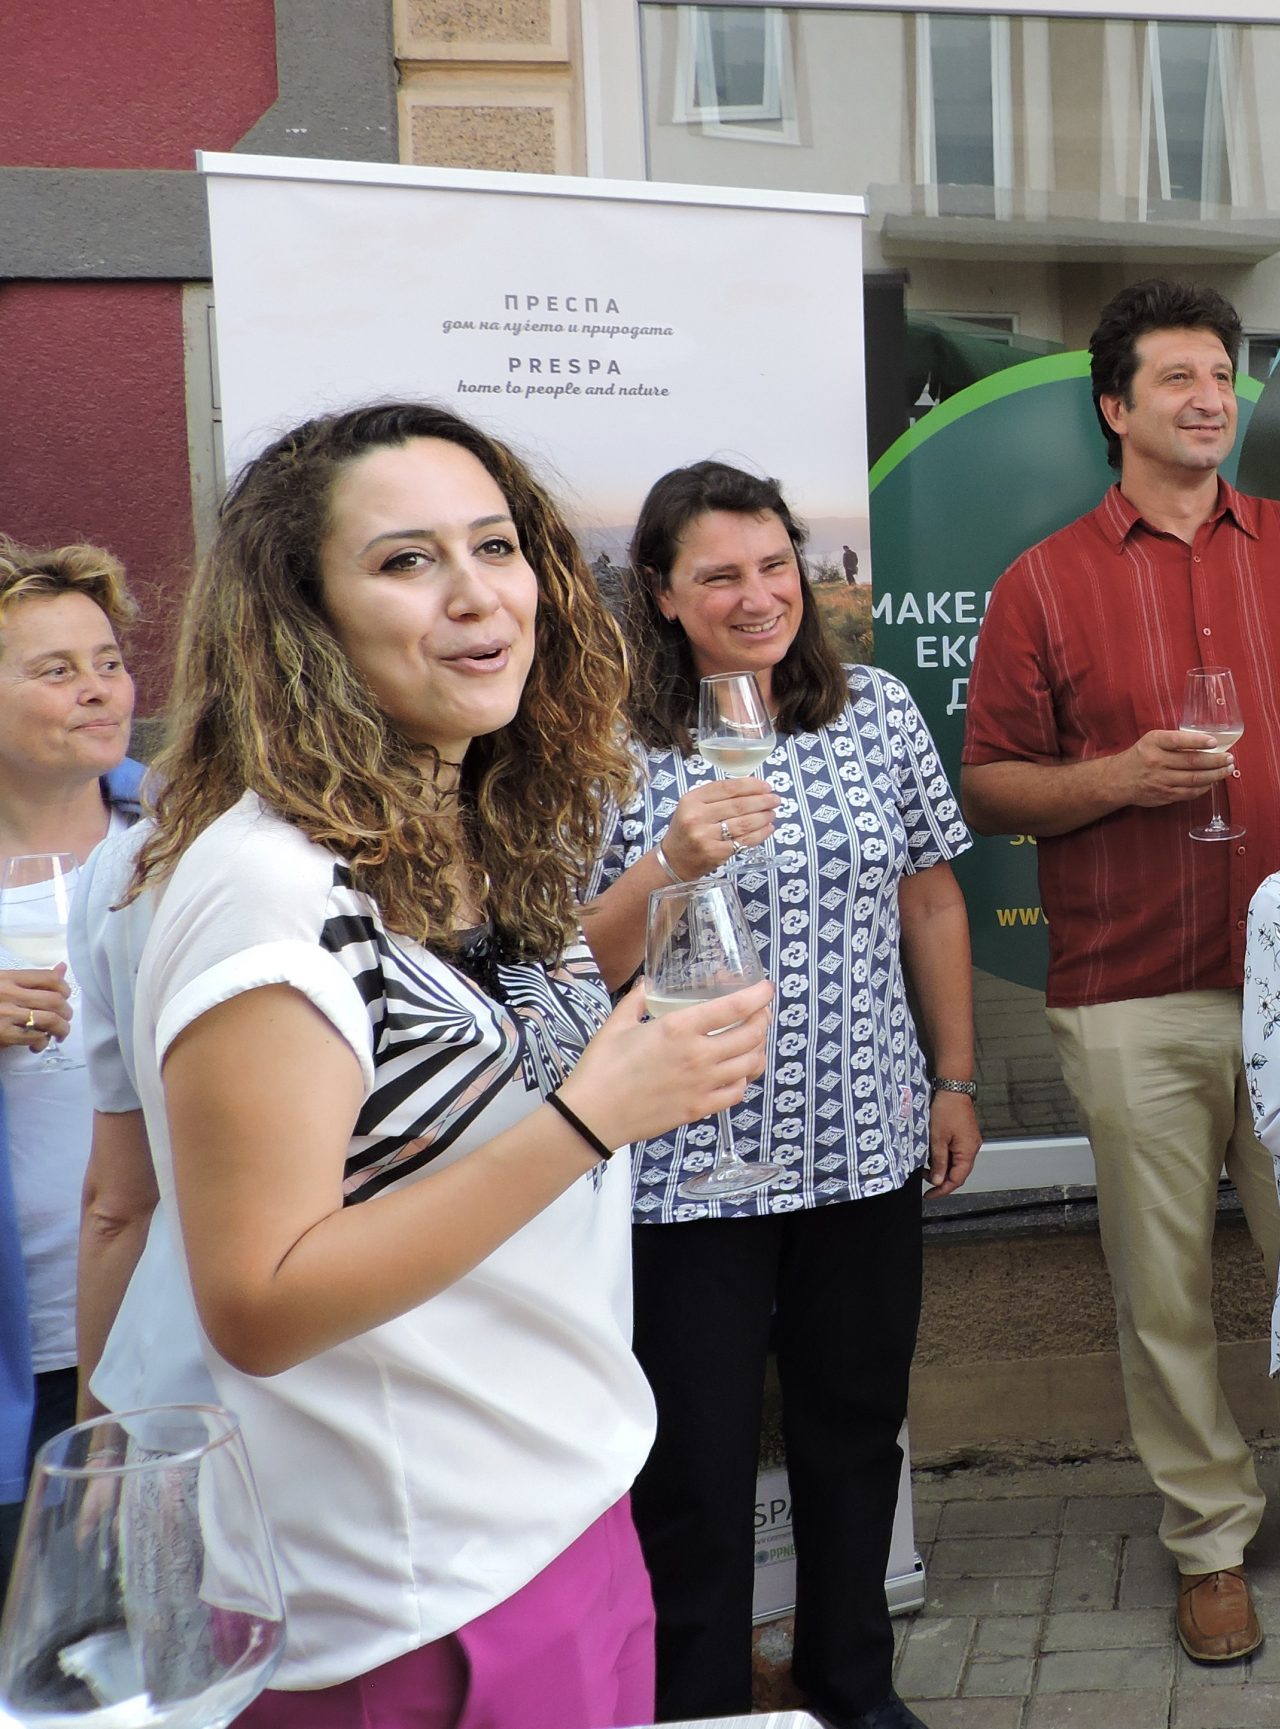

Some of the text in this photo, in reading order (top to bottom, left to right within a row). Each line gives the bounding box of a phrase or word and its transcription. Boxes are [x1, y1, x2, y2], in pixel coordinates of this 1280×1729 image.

[504, 294, 620, 313] ПРЕСПА
[442, 319, 476, 334] дом
[479, 321, 501, 331] на
[567, 323, 579, 333] и
[581, 324, 675, 340] природата
[508, 357, 622, 376] PRESPA
[457, 379, 671, 399] home to people and nature
[996, 906, 1050, 927] ww
[754, 1498, 793, 1528] SP
